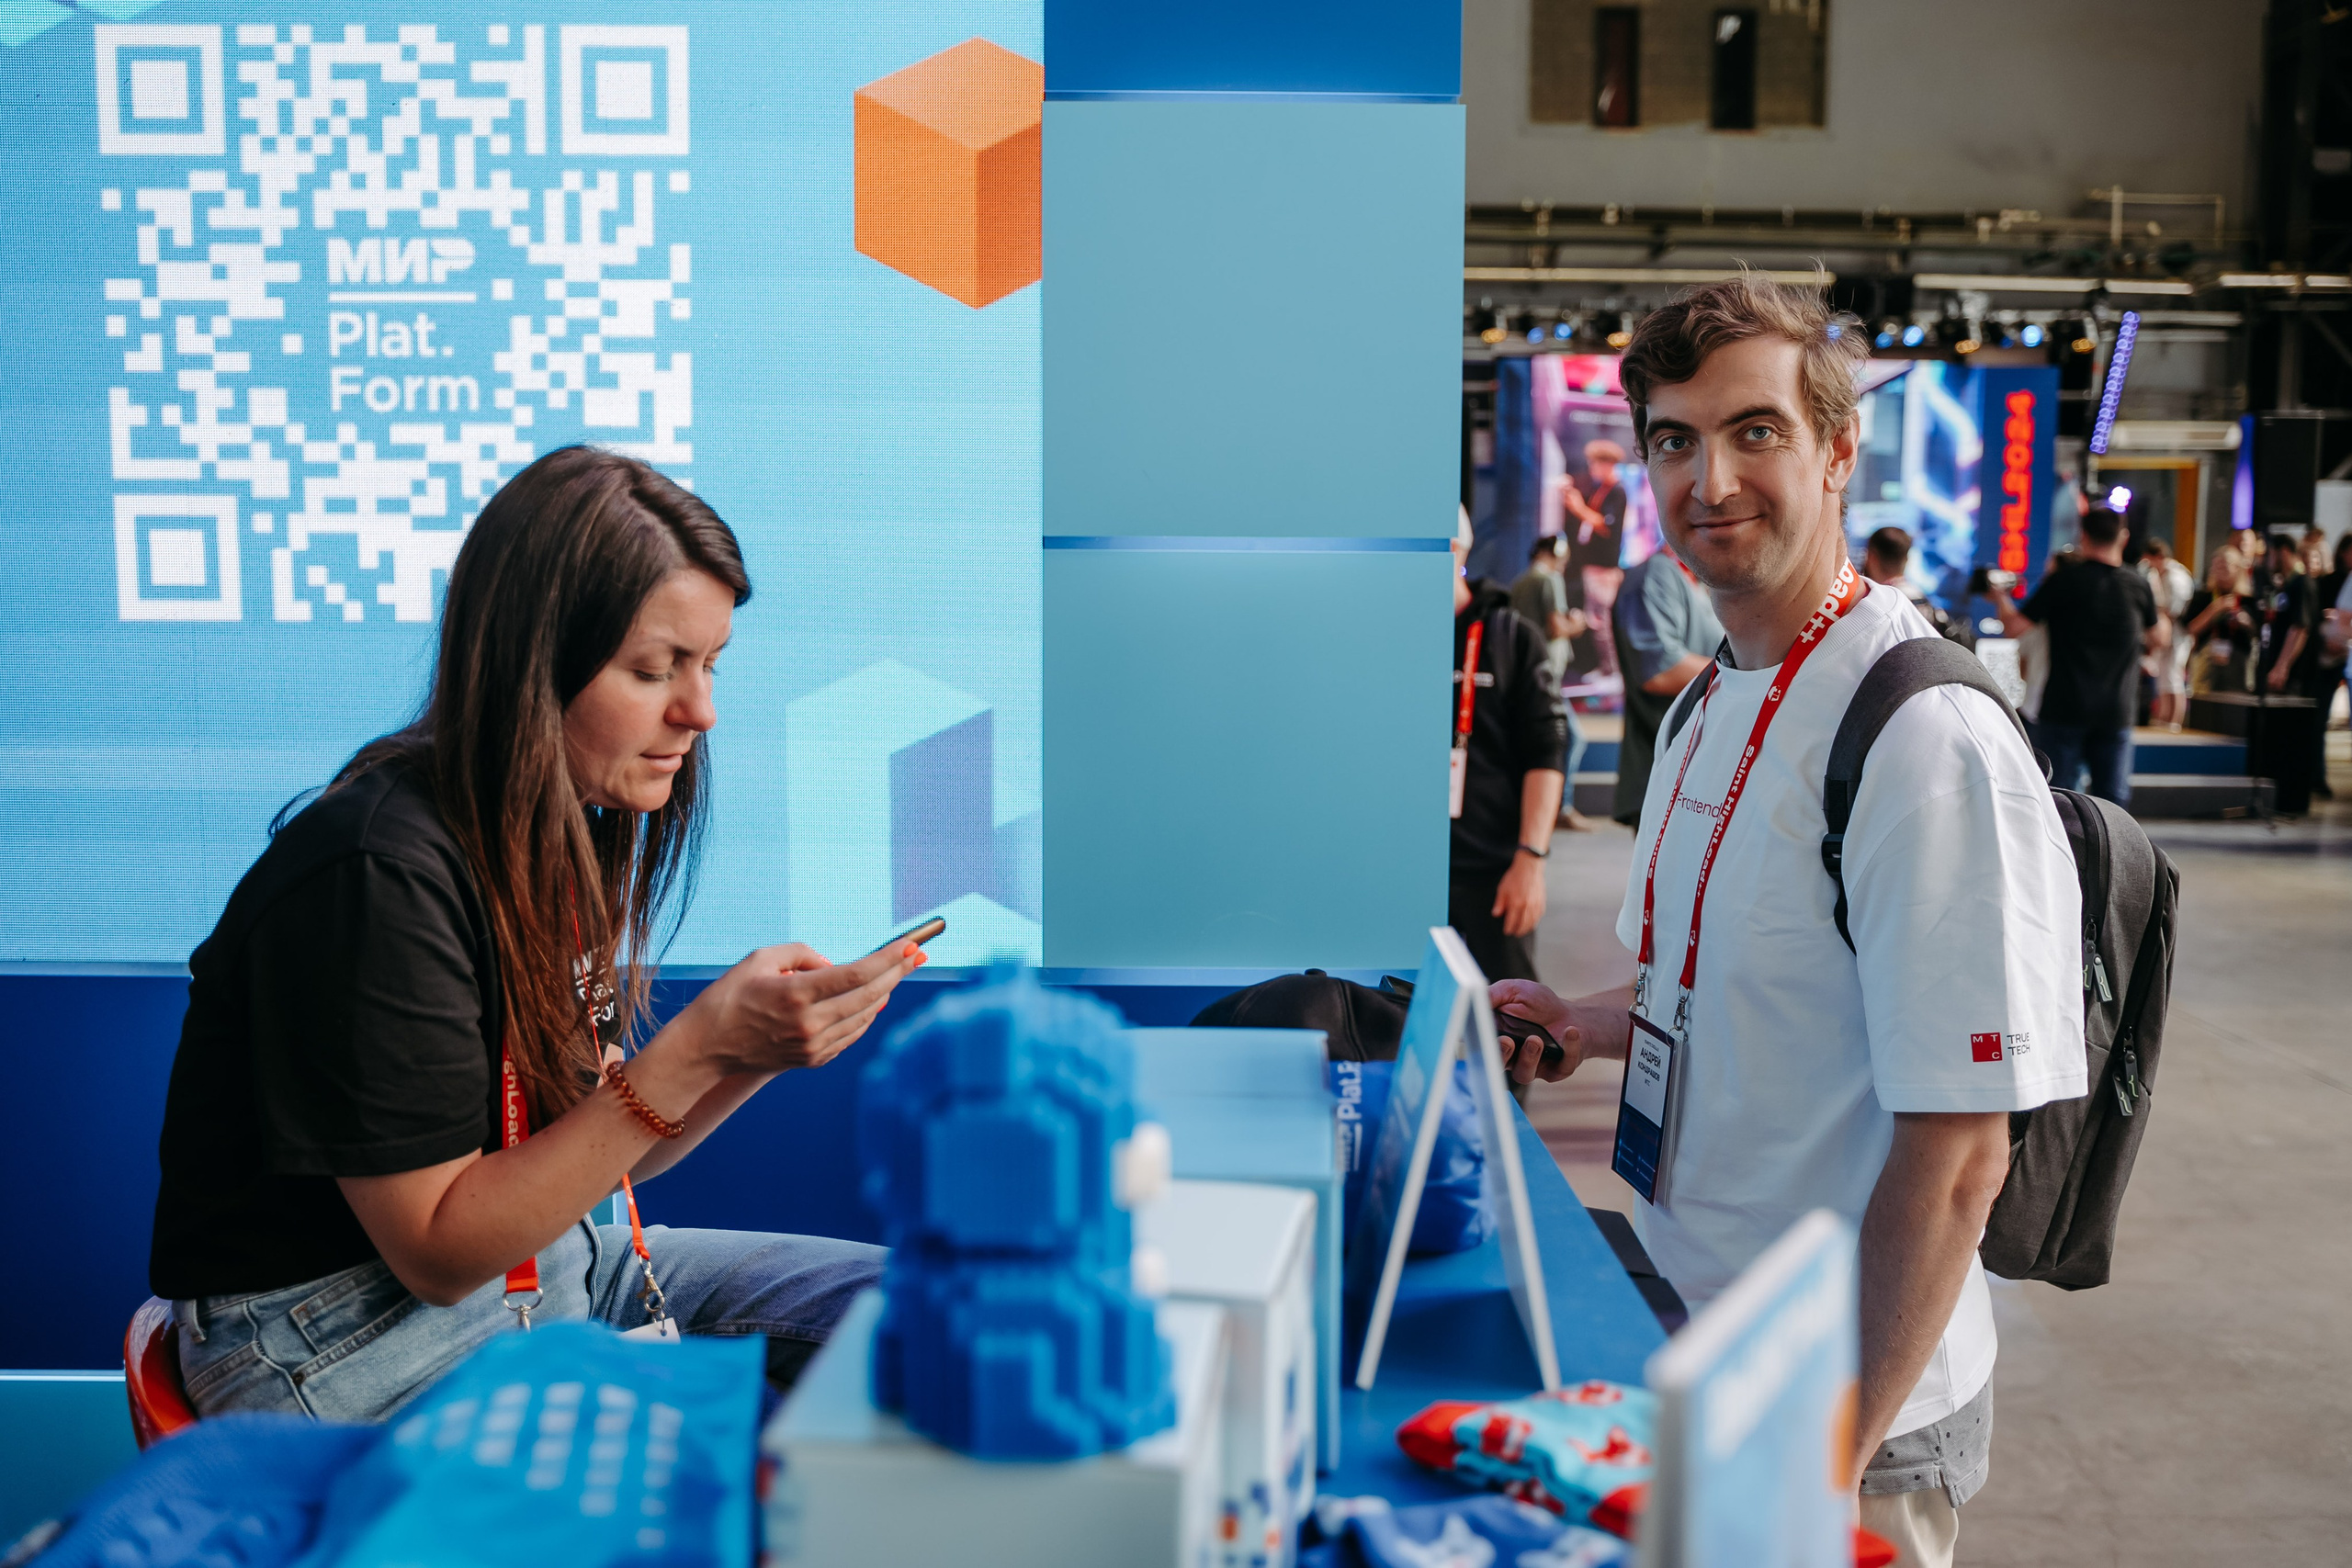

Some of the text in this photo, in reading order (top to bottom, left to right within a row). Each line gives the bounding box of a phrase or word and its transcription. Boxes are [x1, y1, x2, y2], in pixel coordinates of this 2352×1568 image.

[327, 236, 477, 285] МИР
[329, 311, 455, 358] Plat.
[331, 365, 481, 412] Form
[1731, 744, 1755, 794] Saint
[1640, 1045, 1661, 1069] АНДРЕЙ
[2007, 1032, 2030, 1044] TRUE
[2007, 1044, 2030, 1055] TECH
